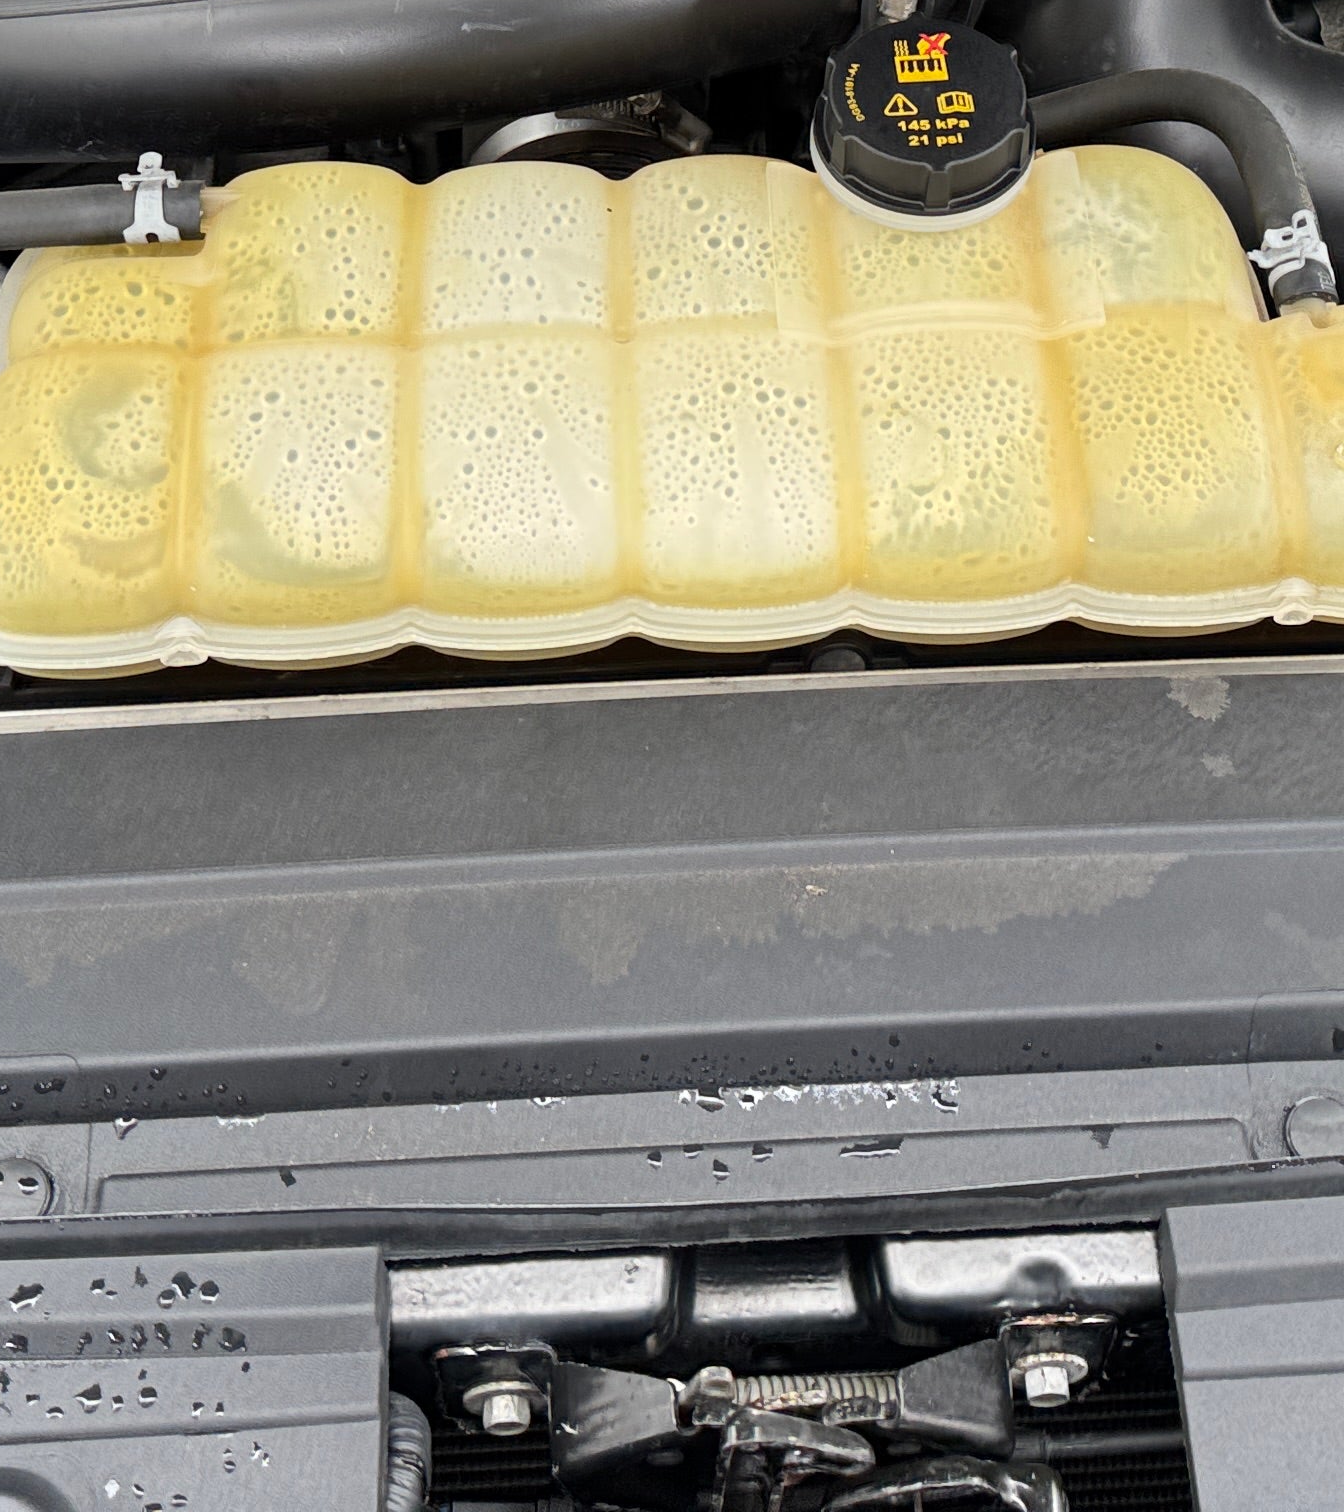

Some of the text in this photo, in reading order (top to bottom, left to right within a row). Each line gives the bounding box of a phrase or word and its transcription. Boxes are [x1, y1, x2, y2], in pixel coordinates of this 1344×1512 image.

[897, 117, 970, 132] 145 kPa
[907, 132, 964, 147] 21 psi
